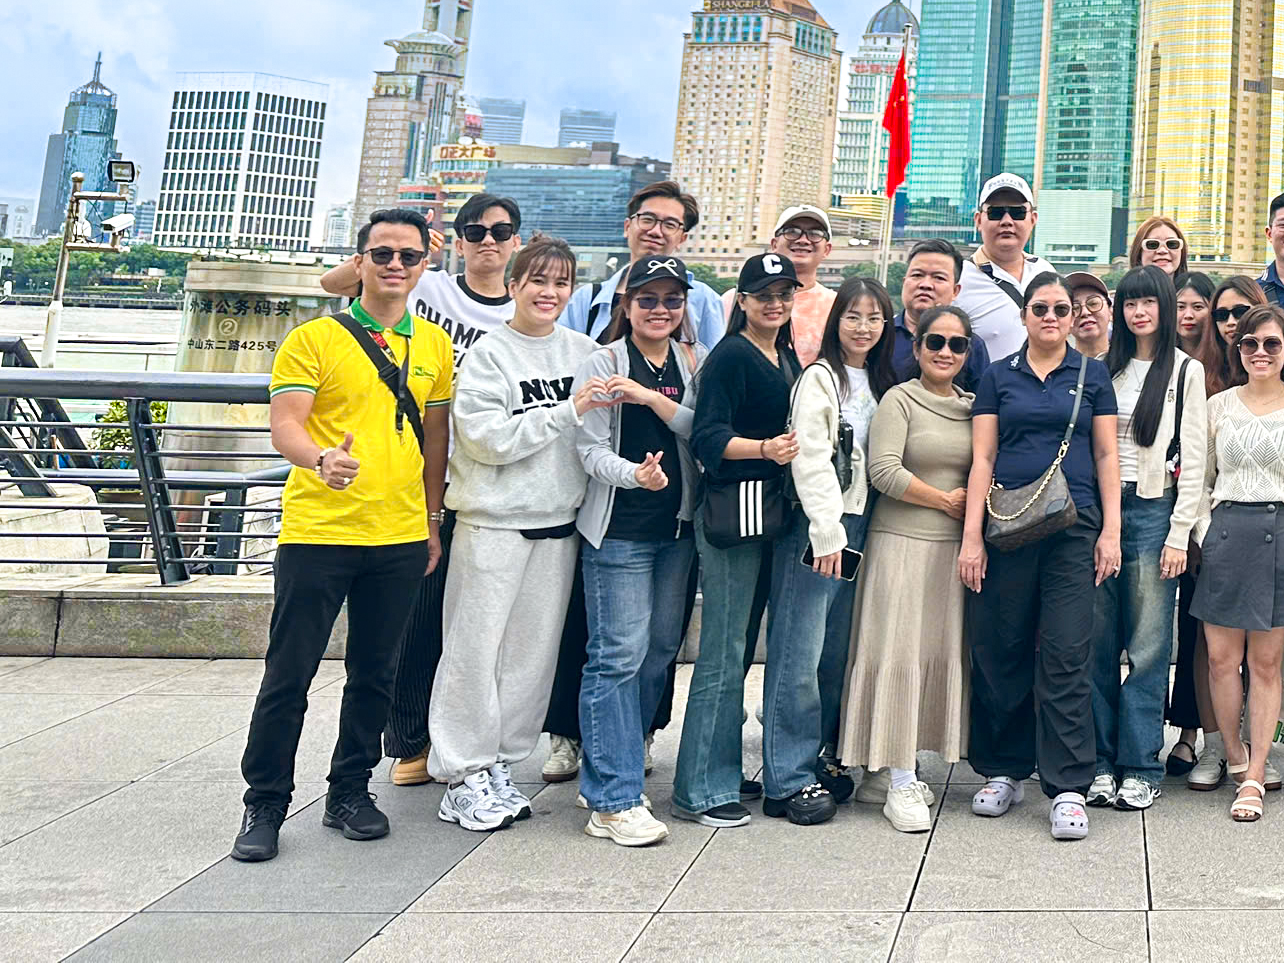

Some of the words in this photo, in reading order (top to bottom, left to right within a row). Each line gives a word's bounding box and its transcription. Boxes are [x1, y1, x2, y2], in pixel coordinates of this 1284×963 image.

[761, 254, 783, 275] C
[190, 300, 292, 317] 外滩公务码头
[187, 338, 278, 353] 中山东二路425号
